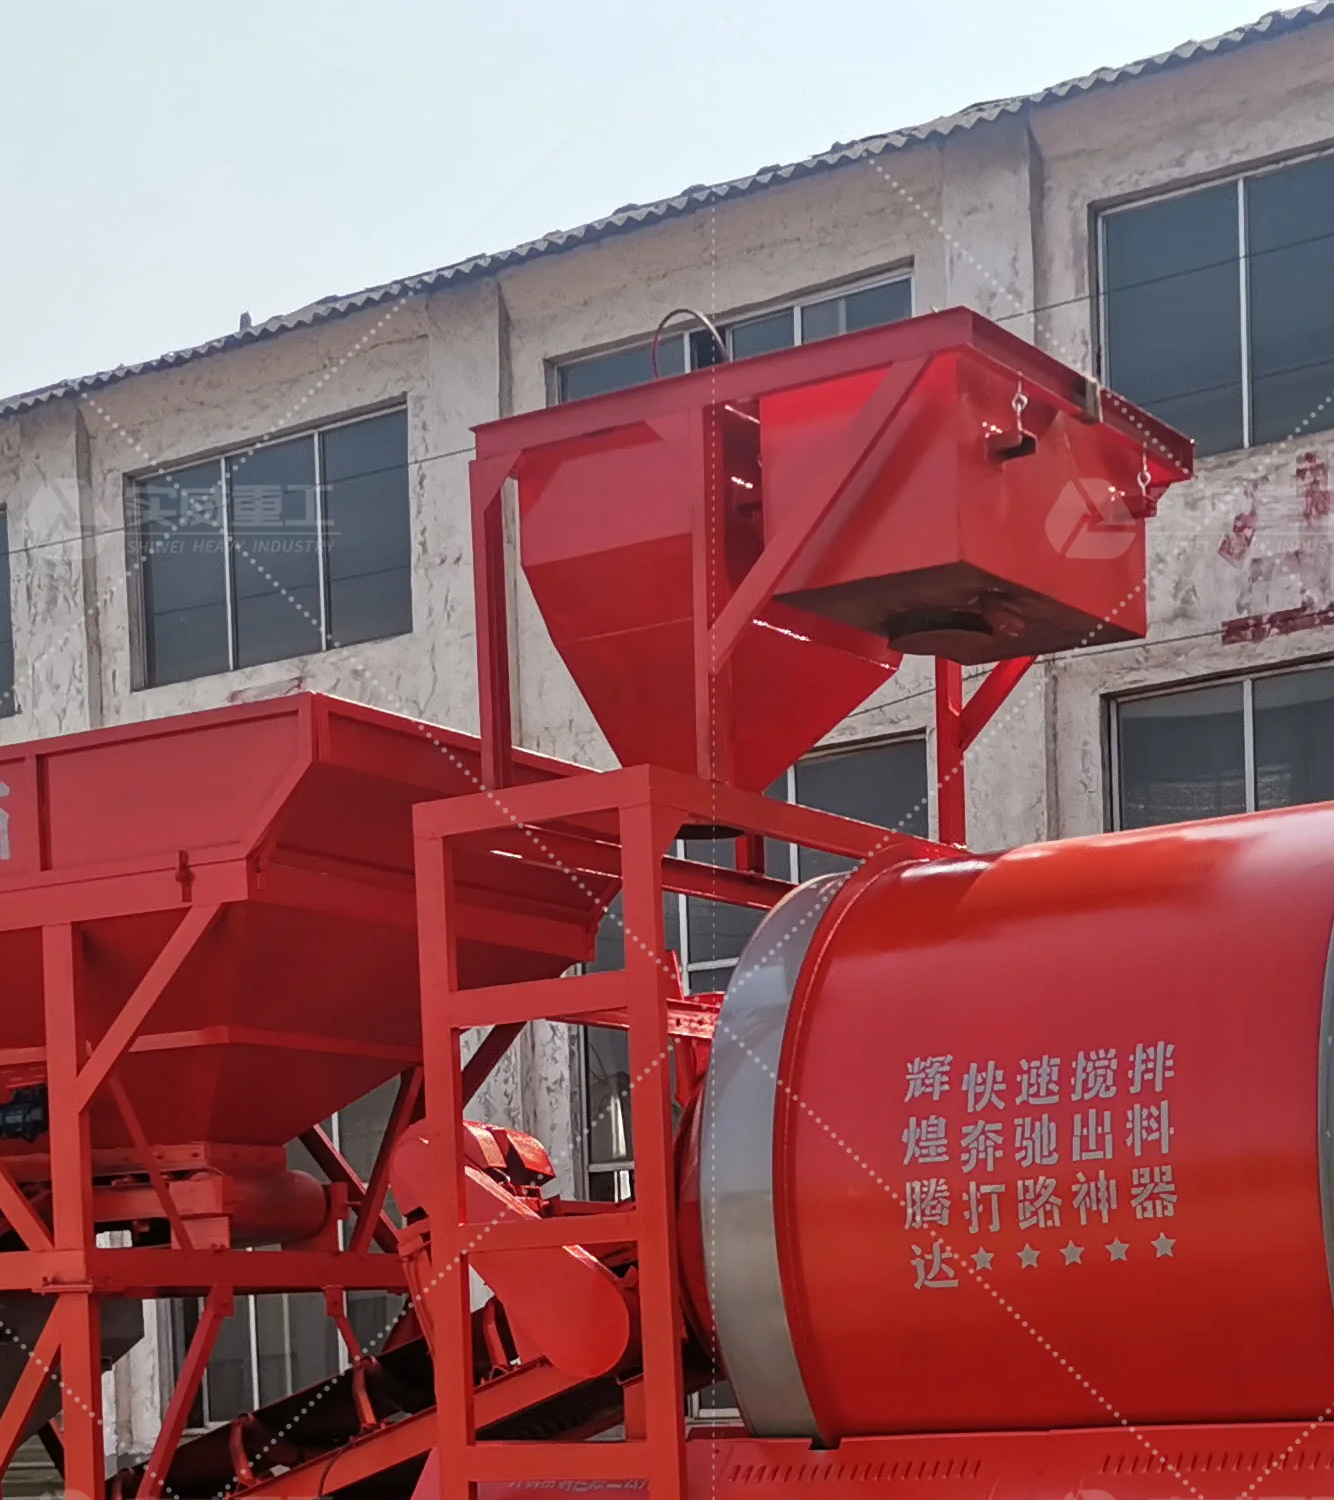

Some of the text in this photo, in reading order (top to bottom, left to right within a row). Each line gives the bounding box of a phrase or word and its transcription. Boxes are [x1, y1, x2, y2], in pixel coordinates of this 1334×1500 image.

[962, 1041, 1175, 1113] 快速搅拌
[961, 1100, 1175, 1174] 奔驰出料
